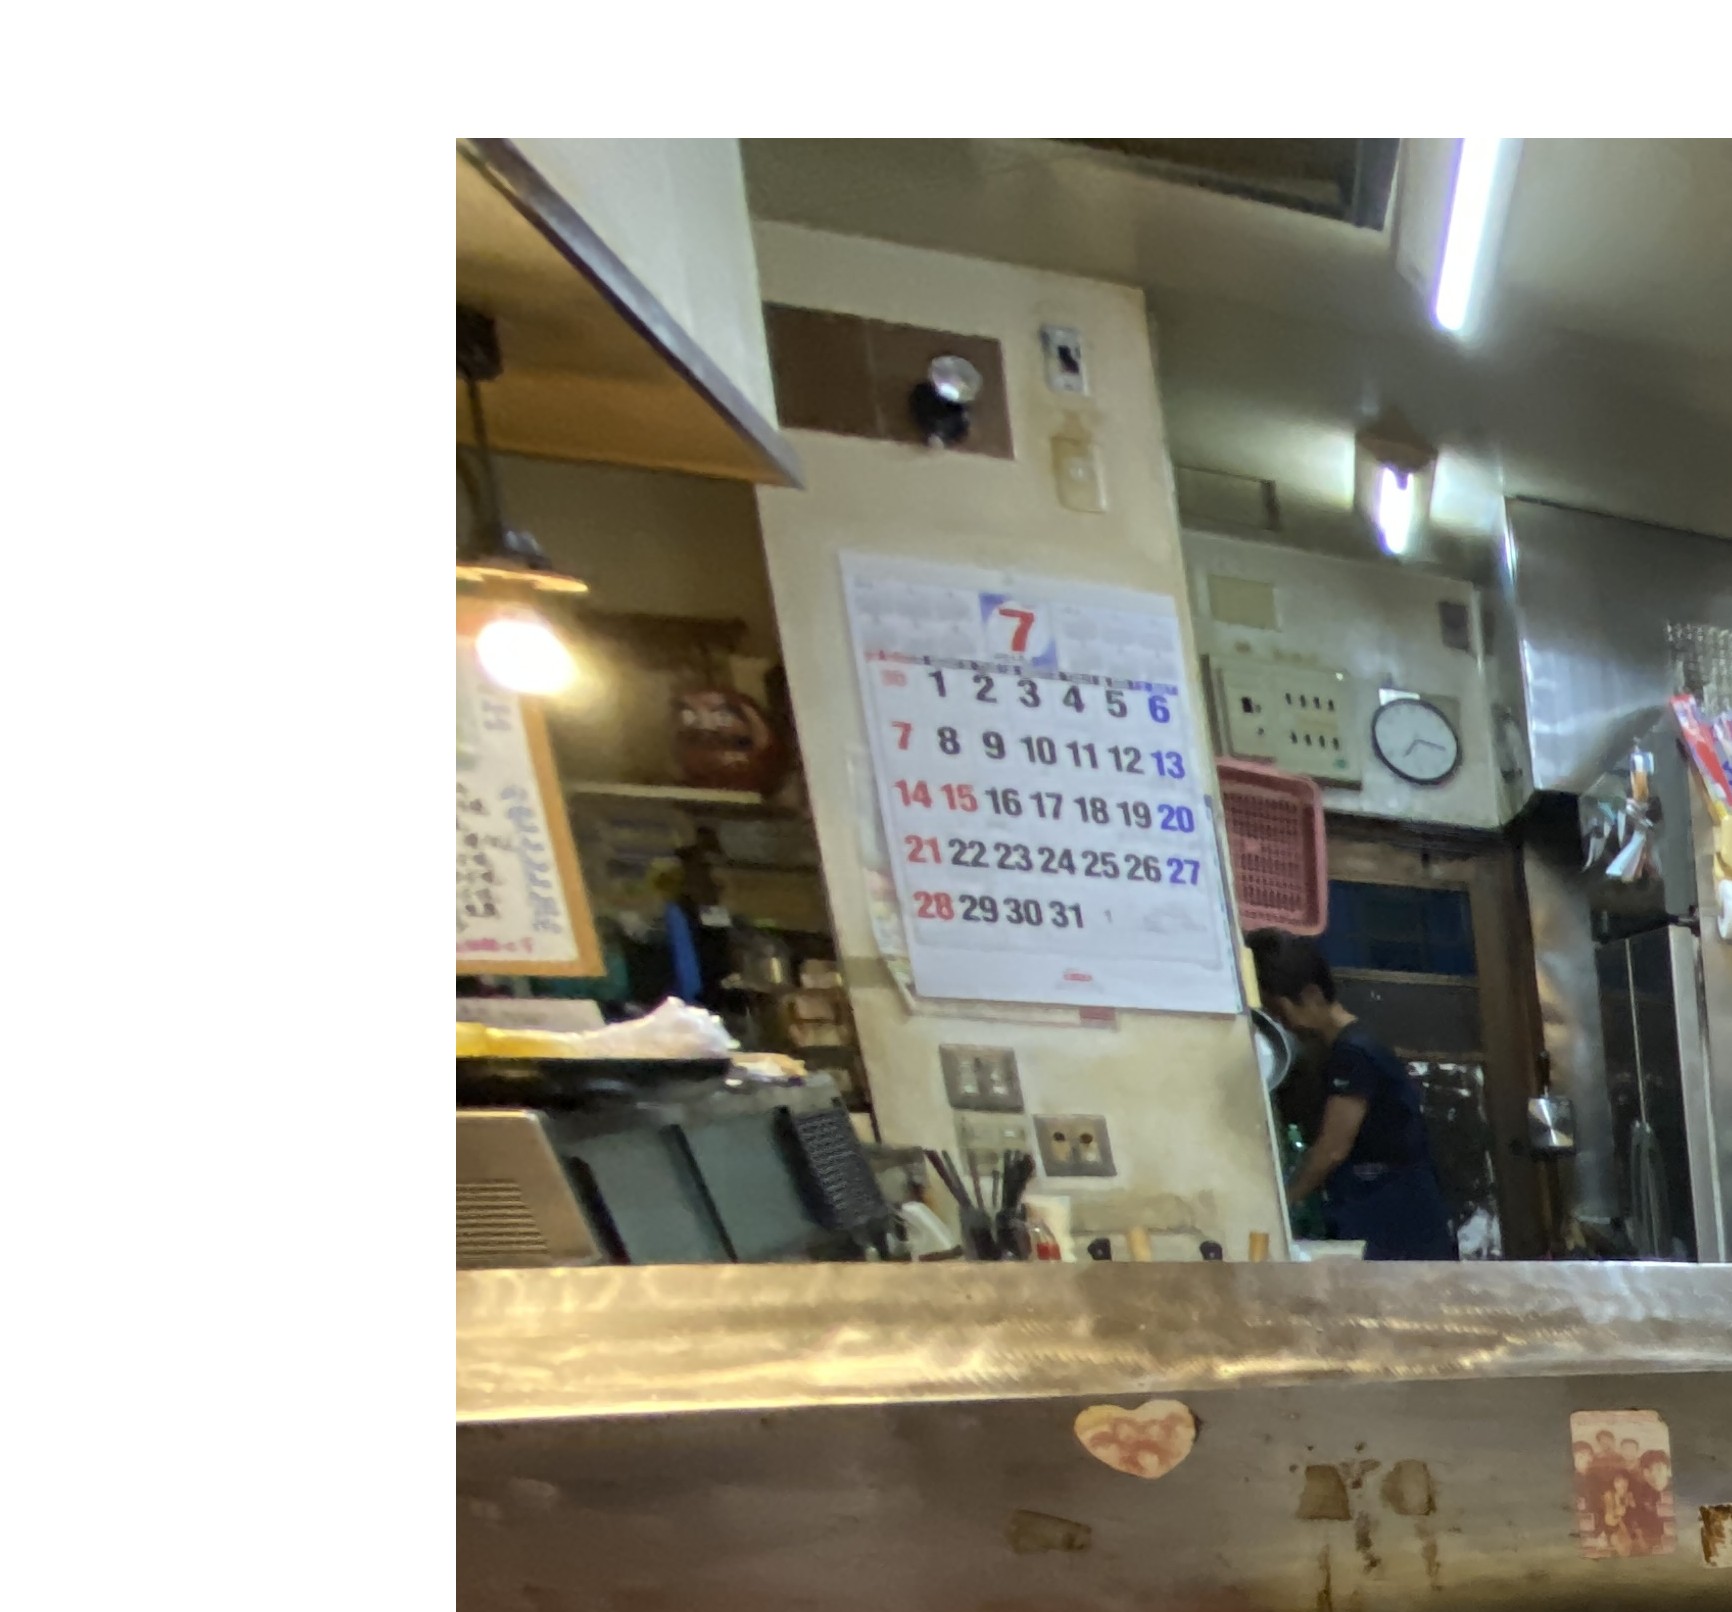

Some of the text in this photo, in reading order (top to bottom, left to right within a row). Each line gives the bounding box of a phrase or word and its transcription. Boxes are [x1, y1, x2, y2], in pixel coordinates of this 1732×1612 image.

[999, 608, 1036, 652] 7
[929, 671, 946, 697] 1
[972, 674, 997, 703] 2
[1017, 680, 1041, 708] 3
[1063, 685, 1085, 713] 4
[1106, 690, 1127, 718] 5
[1147, 694, 1170, 723] 6
[892, 721, 1185, 779] 7 8 9 10 11 12 13
[895, 780, 1194, 833] 14 15 16 17 18 19 20
[905, 835, 1200, 886] 21 22 23 24 25 26 27
[913, 891, 954, 921] 28
[959, 894, 998, 923] 29
[1005, 897, 1043, 927] 30
[1050, 900, 1084, 928] 31
